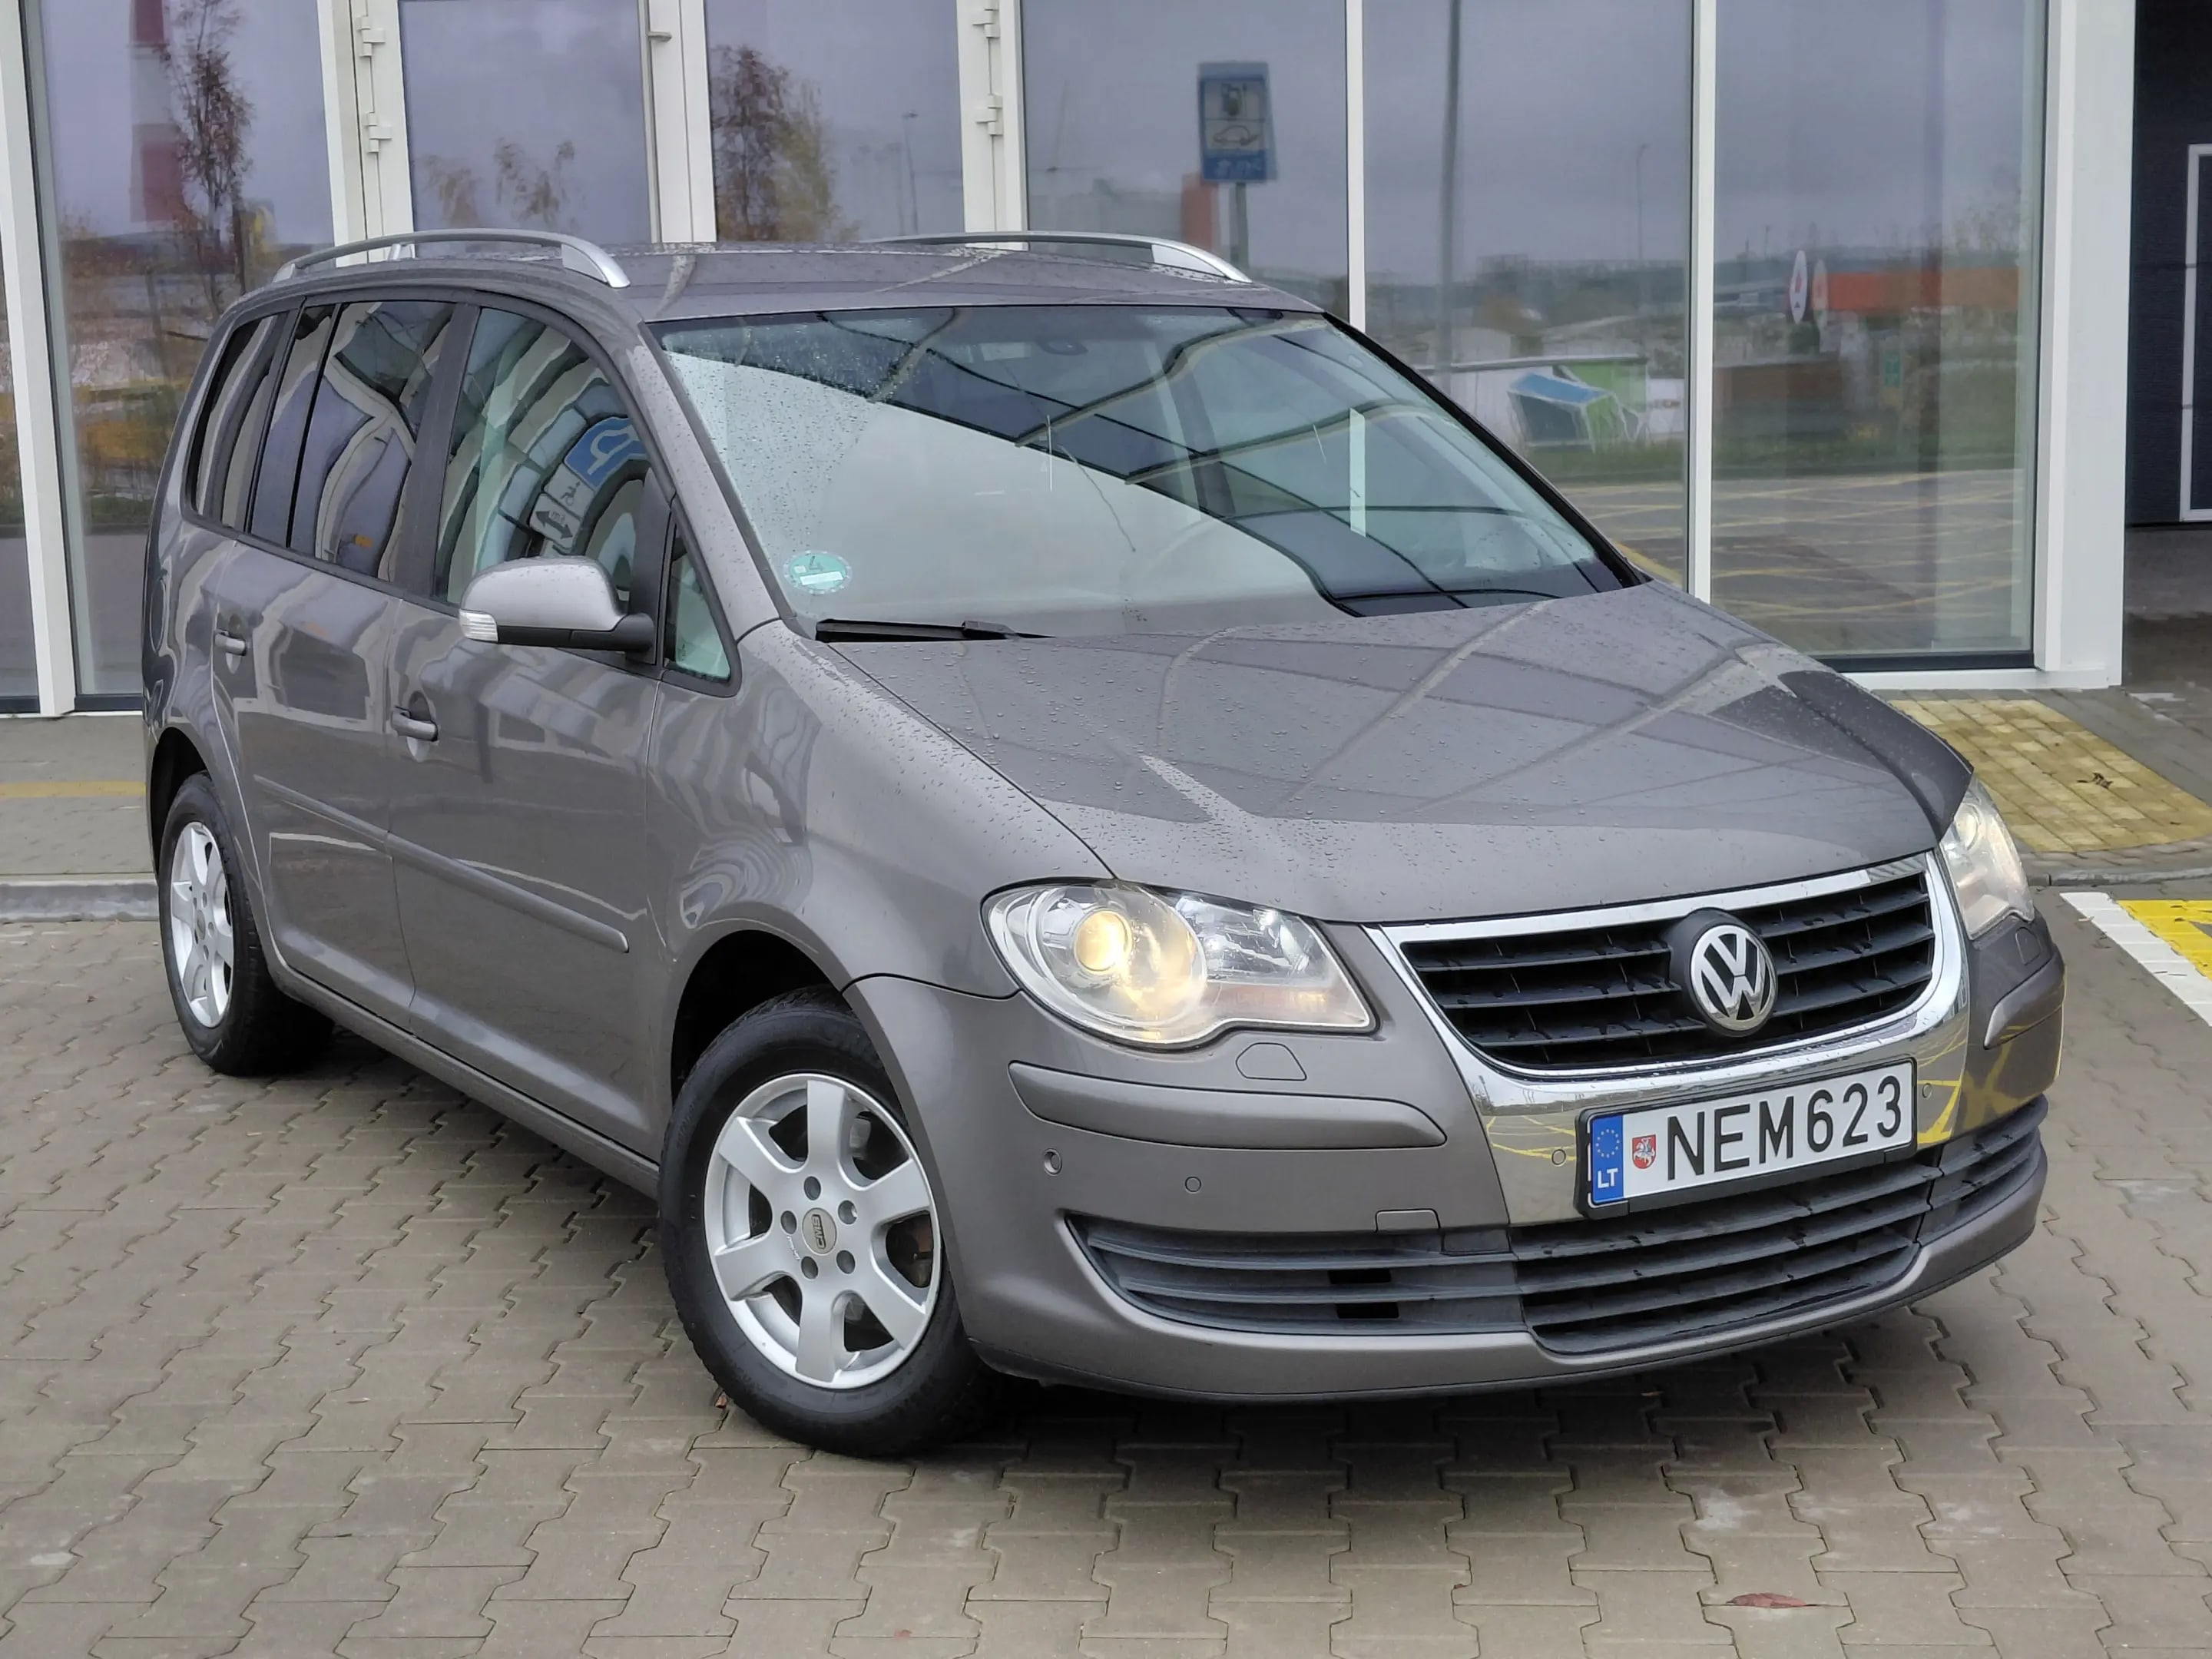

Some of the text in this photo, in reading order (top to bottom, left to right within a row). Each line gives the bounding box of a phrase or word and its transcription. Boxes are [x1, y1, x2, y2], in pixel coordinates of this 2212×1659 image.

[1691, 925, 1777, 1031] VW
[1667, 1075, 1902, 1181] NEM623
[1598, 1167, 1618, 1189] LT
[811, 1214, 826, 1250] CMS
